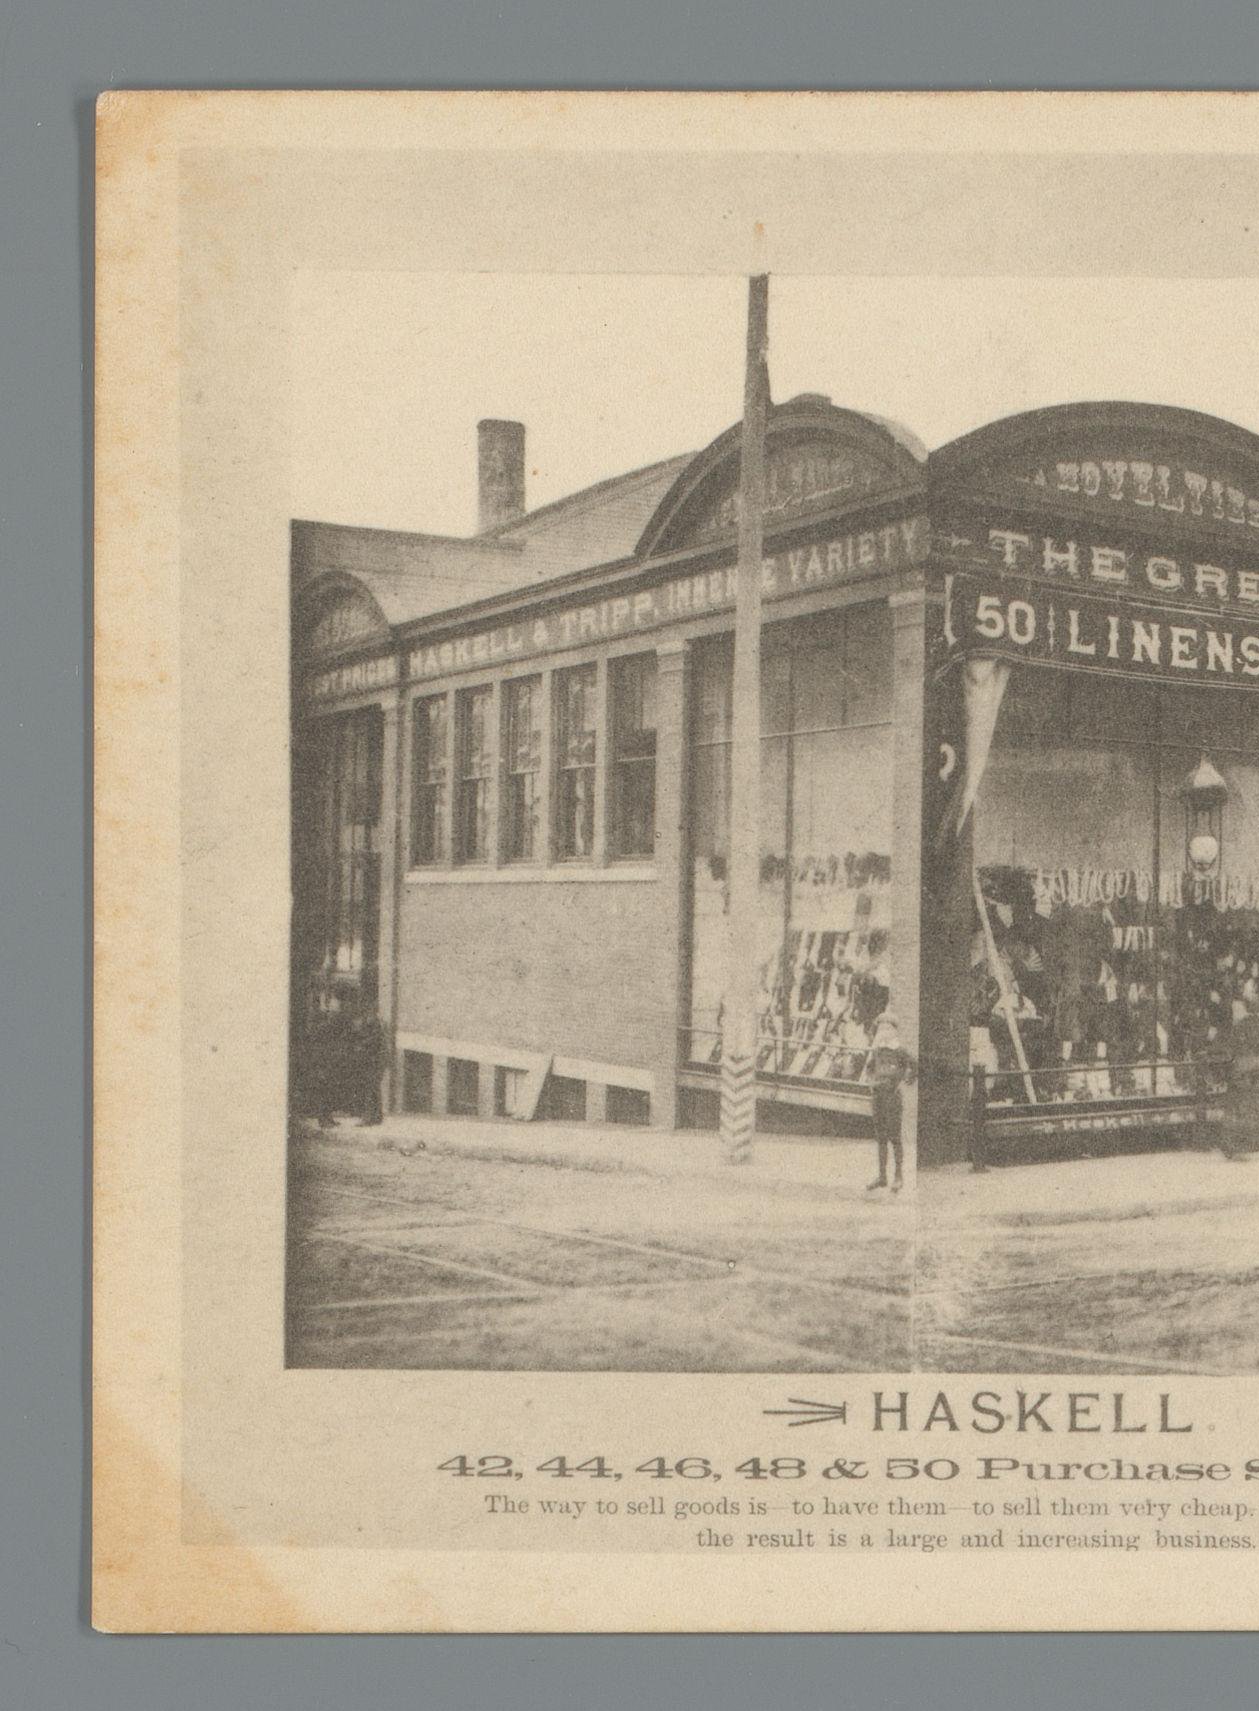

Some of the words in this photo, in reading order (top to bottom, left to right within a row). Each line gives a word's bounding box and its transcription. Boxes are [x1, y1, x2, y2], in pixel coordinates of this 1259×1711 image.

[988, 529, 1128, 584] THE
[409, 627, 523, 676] HASKELL
[532, 619, 549, 646] &
[667, 556, 777, 610] IMMENE
[787, 521, 918, 583] VARIETY
[974, 595, 1036, 645] 50
[872, 1391, 1193, 1434] HASKELL
[436, 1455, 524, 1481] 42,
[535, 1456, 623, 1482] 44,
[634, 1457, 723, 1483] 46,
[734, 1457, 808, 1480] 48
[821, 1458, 870, 1480] &
[886, 1458, 961, 1480] 50
[976, 1458, 1232, 1481] Purchase
[483, 1494, 530, 1515] The
[537, 1499, 587, 1520] way
[595, 1498, 619, 1516] to
[626, 1495, 666, 1516] sell
[673, 1495, 741, 1520] goods
[822, 1495, 879, 1516] have
[1002, 1496, 1042, 1517] sell
[1050, 1496, 1109, 1517] them
[1119, 1498, 1172, 1522] very
[695, 1527, 734, 1548] the
[746, 1528, 816, 1549] result
[828, 1528, 848, 1548] is
[859, 1533, 875, 1548] a
[886, 1527, 948, 1554] large
[960, 1528, 1005, 1549] and
[1017, 1528, 1141, 1552] increasing
[1155, 1529, 1257, 1550] business.
